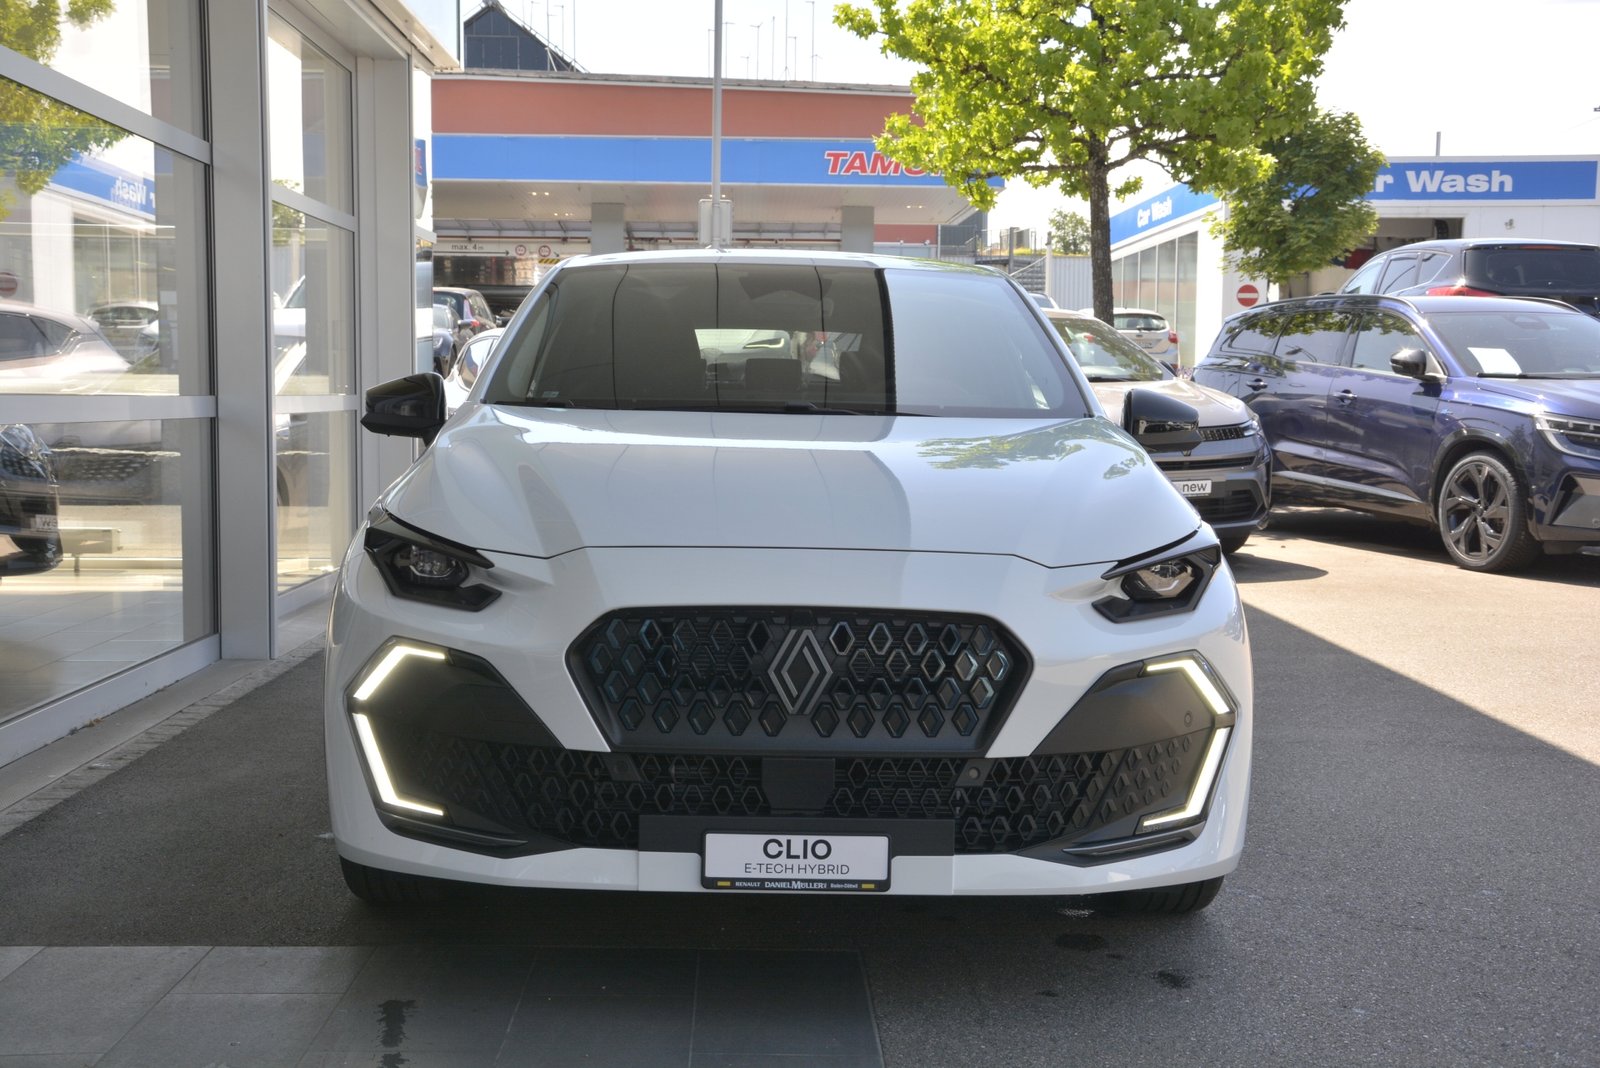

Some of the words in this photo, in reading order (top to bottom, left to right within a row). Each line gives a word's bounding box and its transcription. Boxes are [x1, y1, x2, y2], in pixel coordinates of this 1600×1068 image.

[825, 150, 941, 176] TAM
[1405, 170, 1513, 193] Wash
[1137, 208, 1151, 228] Car
[1151, 196, 1172, 222] Wash
[1182, 482, 1208, 492] new
[763, 838, 832, 860] CLIO
[744, 863, 794, 874] E-TECH
[797, 863, 850, 875] HYBRID
[764, 881, 792, 889] DANIEL
